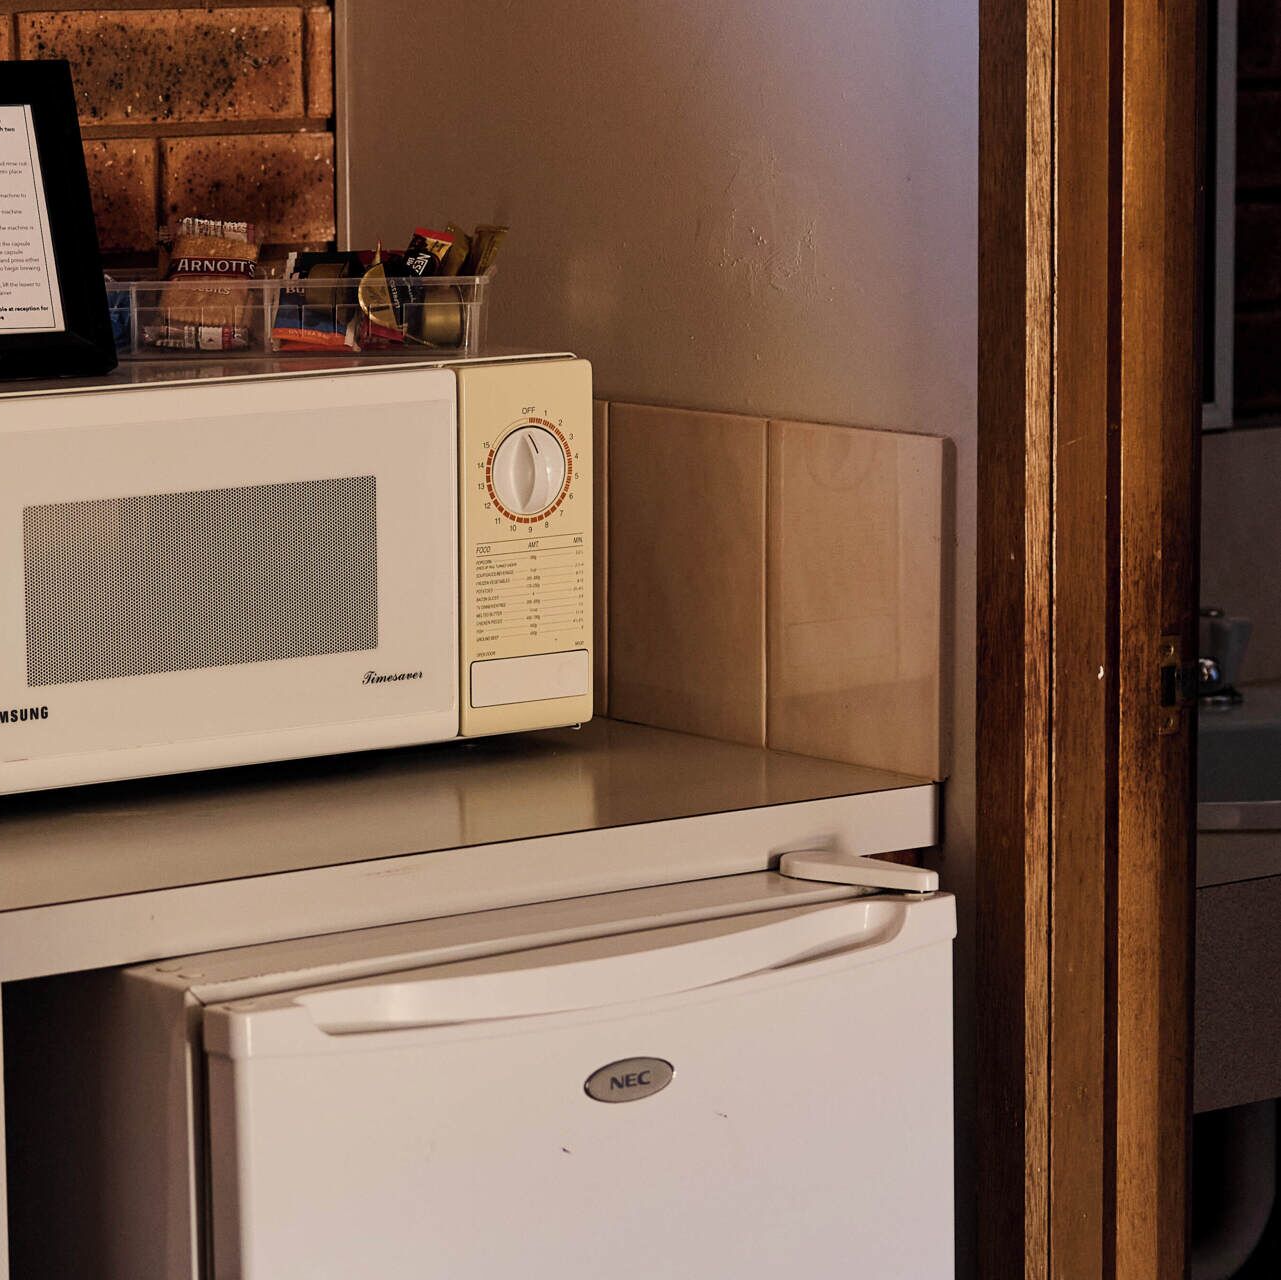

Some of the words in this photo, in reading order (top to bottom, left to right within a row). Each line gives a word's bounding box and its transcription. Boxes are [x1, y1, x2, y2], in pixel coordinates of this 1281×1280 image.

[177, 258, 256, 278] ARNOTT'S
[522, 406, 535, 414] OFF
[476, 546, 491, 554] FOOD
[362, 670, 423, 685] Timesaver
[610, 1070, 651, 1091] NEC
